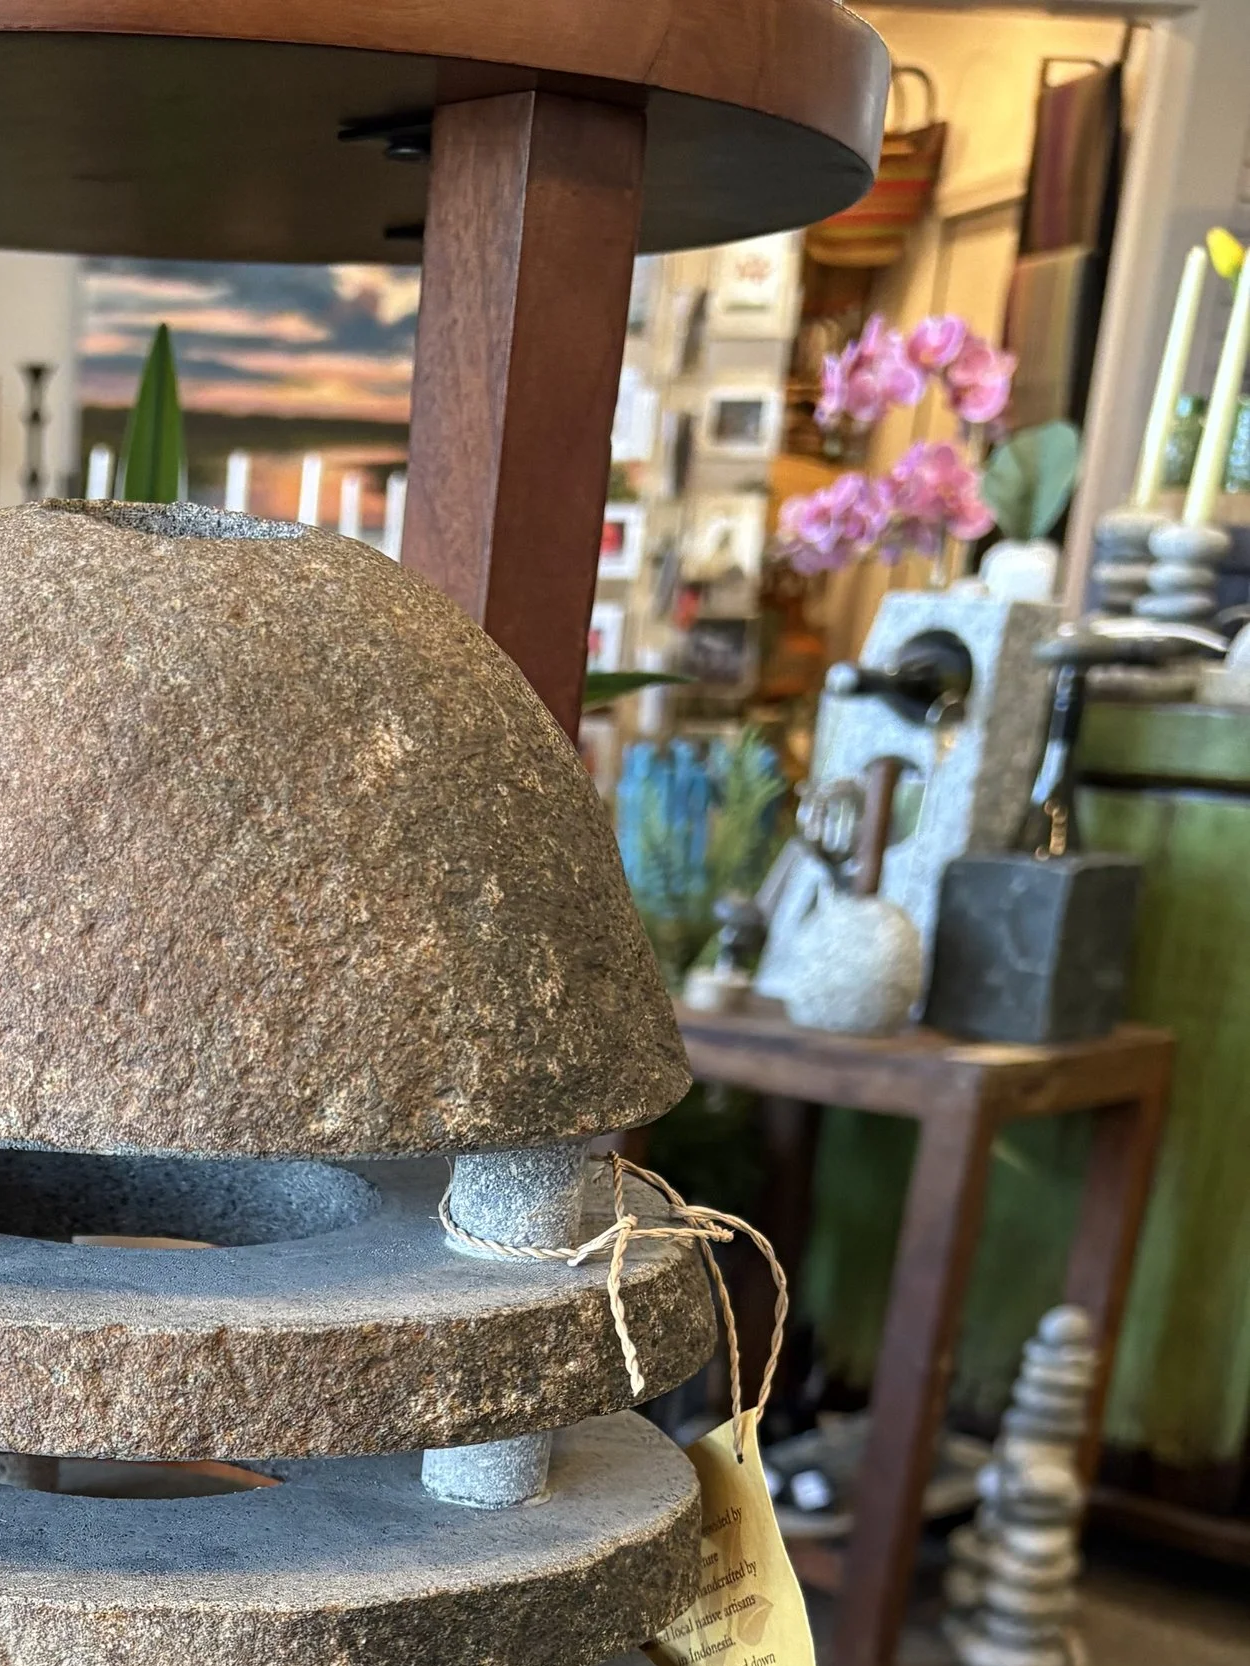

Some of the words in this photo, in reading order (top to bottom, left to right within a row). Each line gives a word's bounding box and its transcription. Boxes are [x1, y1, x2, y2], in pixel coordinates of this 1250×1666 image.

[731, 1506, 742, 1524] by
[695, 1562, 746, 1599] handcrafted
[744, 1560, 757, 1577] by
[670, 1618, 694, 1640] local
[695, 1609, 722, 1629] native
[724, 1594, 756, 1617] artisans
[688, 1634, 736, 1664] Indonesia.
